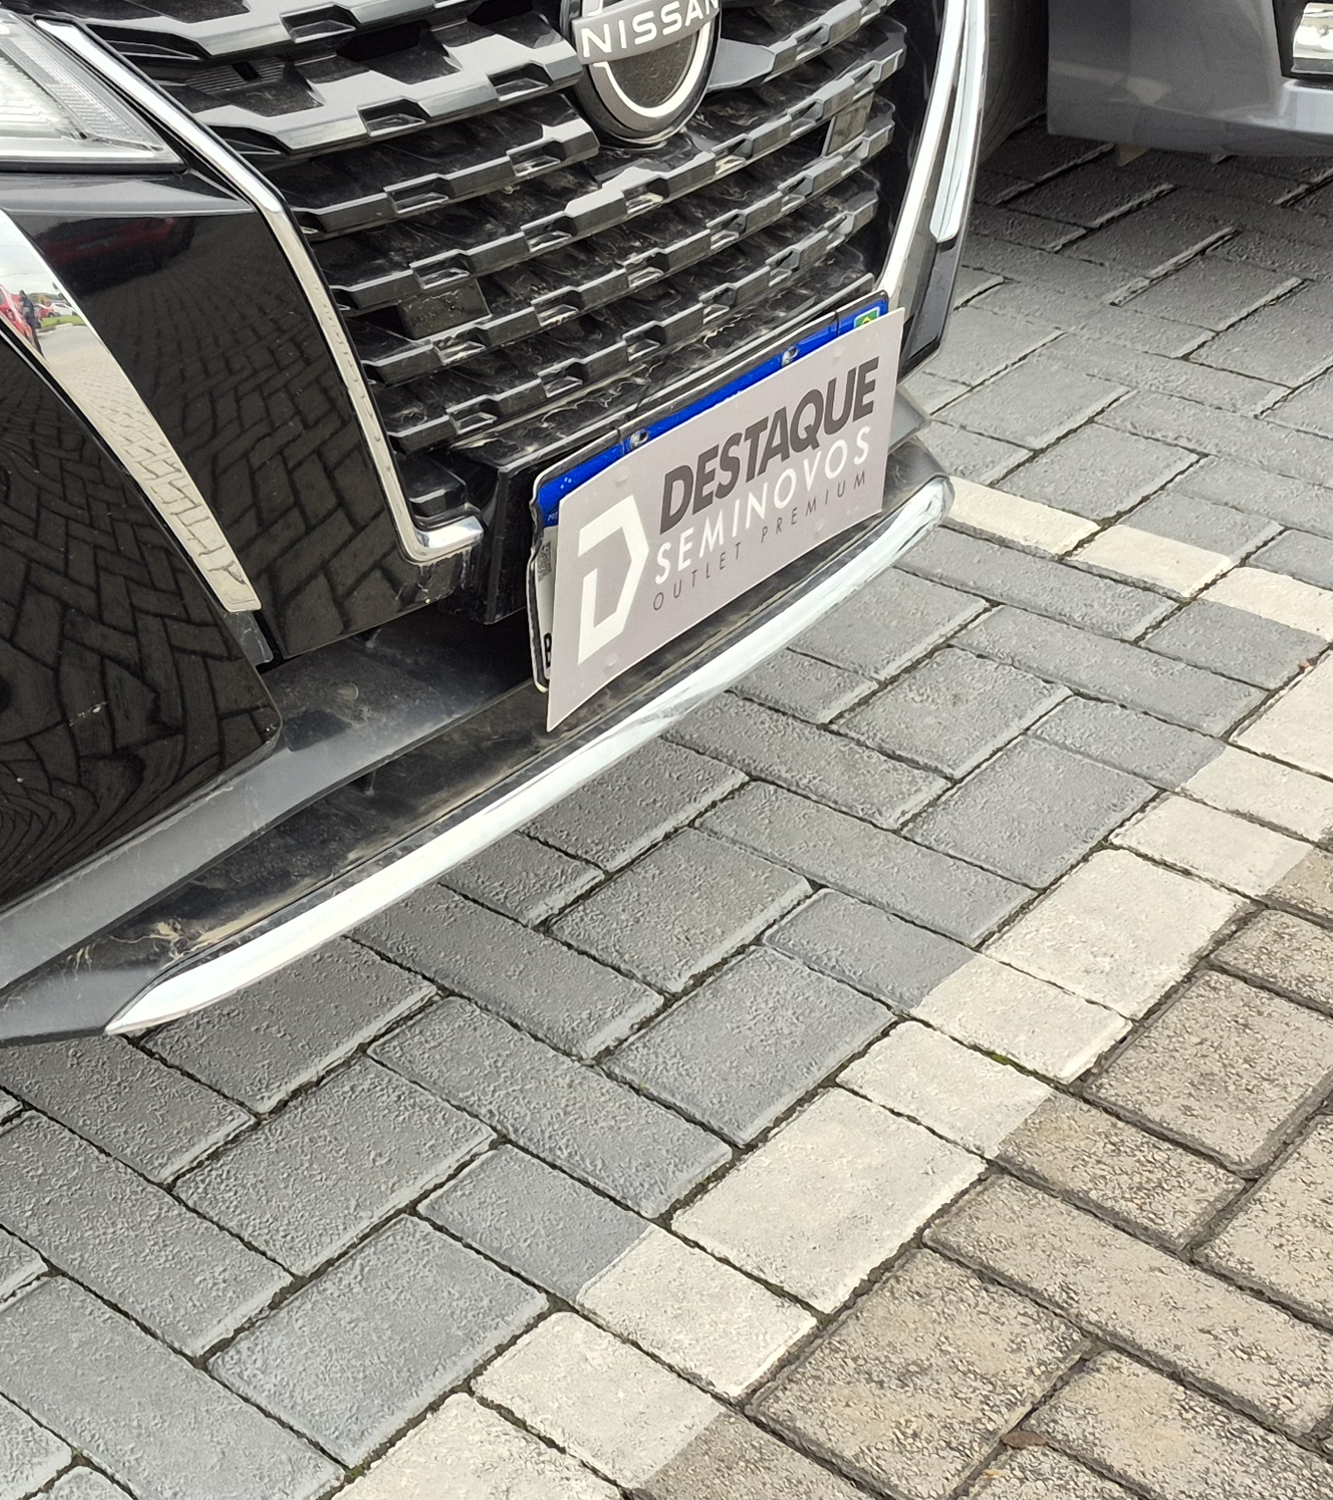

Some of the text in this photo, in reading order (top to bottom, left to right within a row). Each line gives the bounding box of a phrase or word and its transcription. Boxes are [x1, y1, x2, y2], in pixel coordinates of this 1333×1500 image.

[655, 426, 871, 585] SEMINOVOS
[659, 355, 879, 535] DESTAQUE
[652, 475, 868, 612] OUTLET PREMIUM
